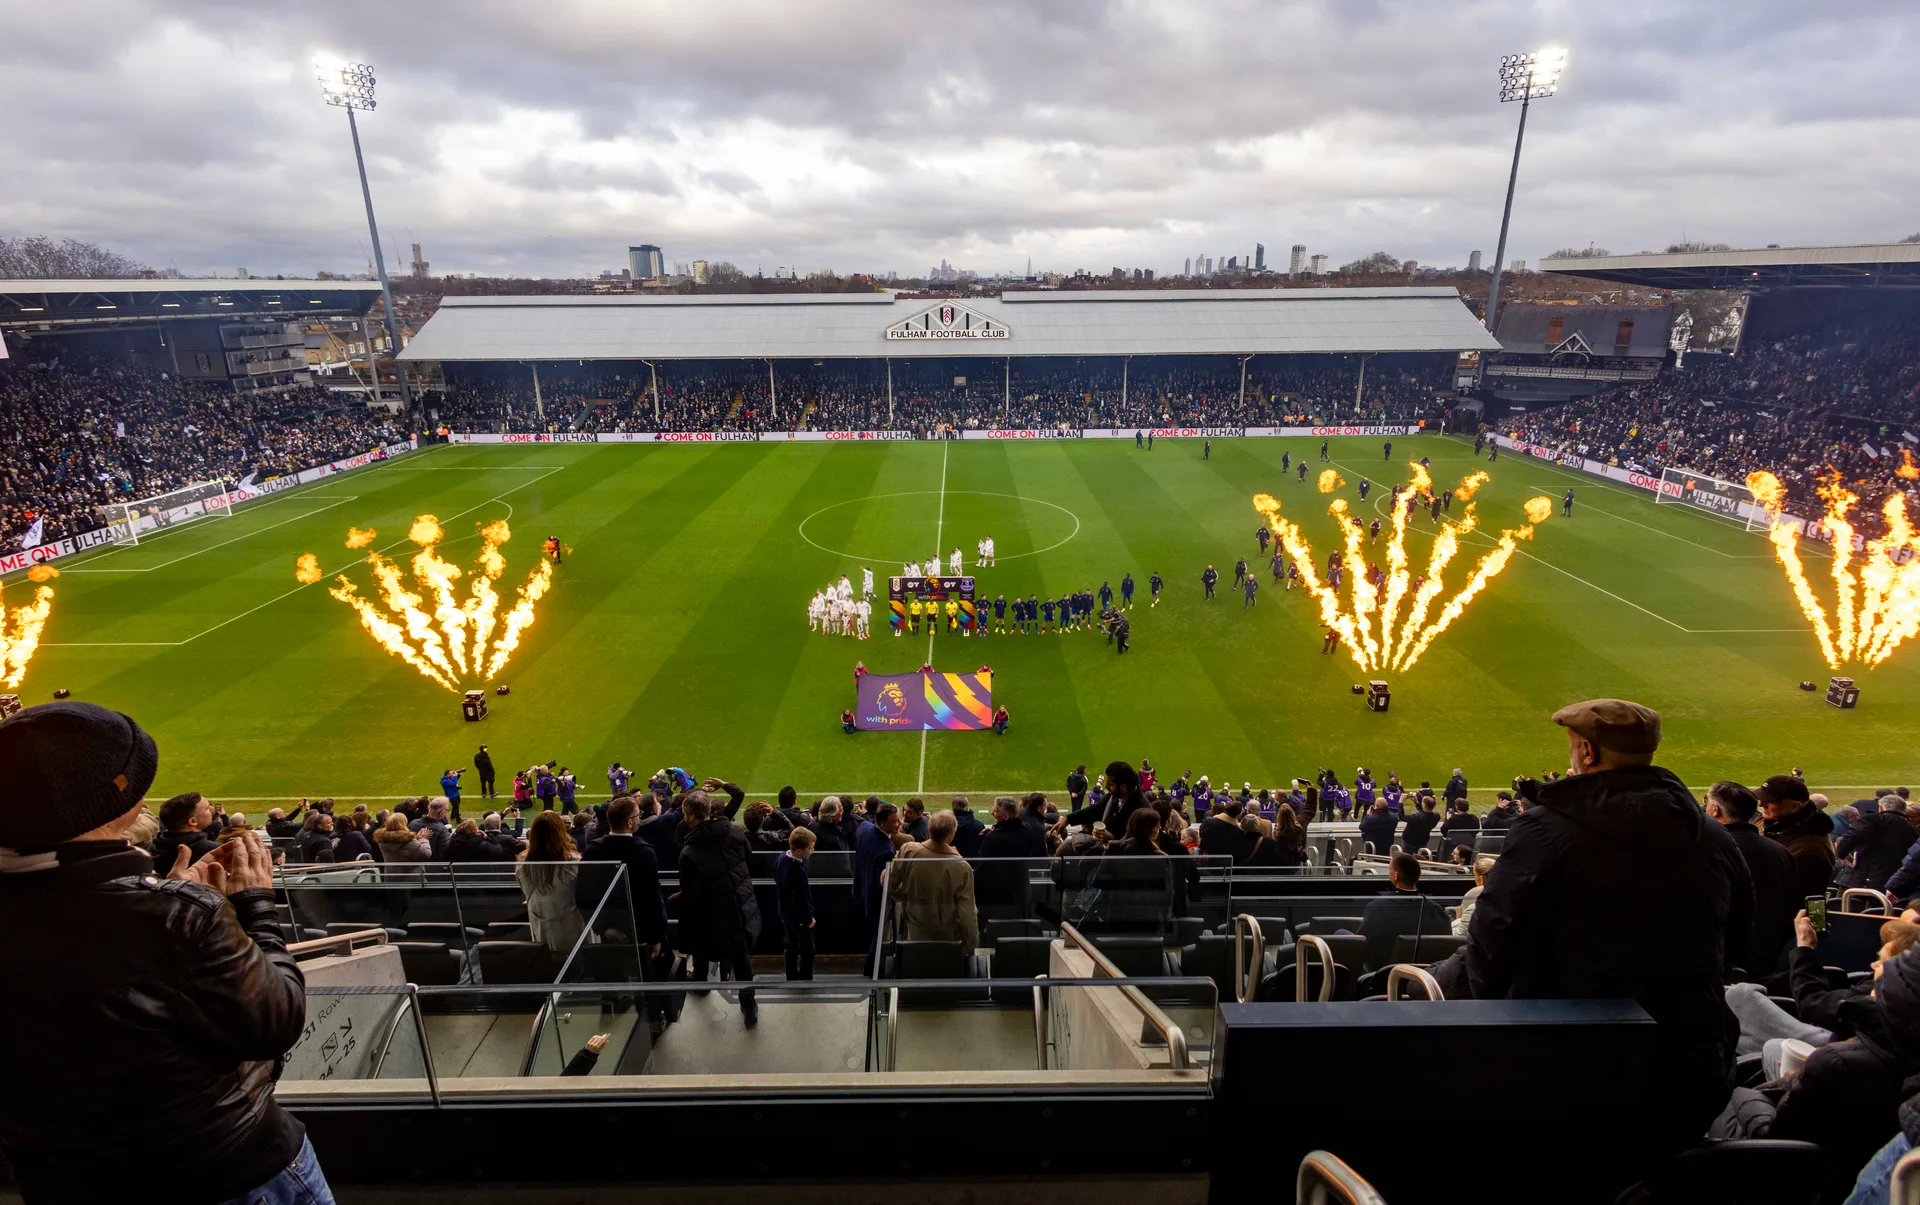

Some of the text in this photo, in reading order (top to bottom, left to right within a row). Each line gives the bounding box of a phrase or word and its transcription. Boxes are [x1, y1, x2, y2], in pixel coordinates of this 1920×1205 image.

[890, 330, 1005, 338] FULHAM FOOTBALL CLUB
[825, 431, 855, 440] COME
[876, 431, 912, 440] FULHA
[987, 430, 1016, 439] COME
[1019, 430, 1036, 439] ON
[1150, 428, 1242, 437] COME ON FULHAM
[1311, 426, 1407, 436] COME ON FULHAM
[501, 433, 532, 443] COME
[552, 433, 596, 443] FULHAM
[663, 432, 757, 442] COME ON FULHAM
[345, 454, 369, 469] COME
[1534, 446, 1547, 458] ON
[1547, 450, 1582, 469] FUHAM
[1628, 473, 1660, 491] COME
[1661, 482, 1681, 497] ON
[201, 494, 235, 512] COME
[31, 543, 59, 563] ON
[866, 715, 913, 726] with pride
[1360, 781, 1372, 791] 10
[303, 1021, 316, 1042] 31
[343, 1036, 356, 1058] 25
